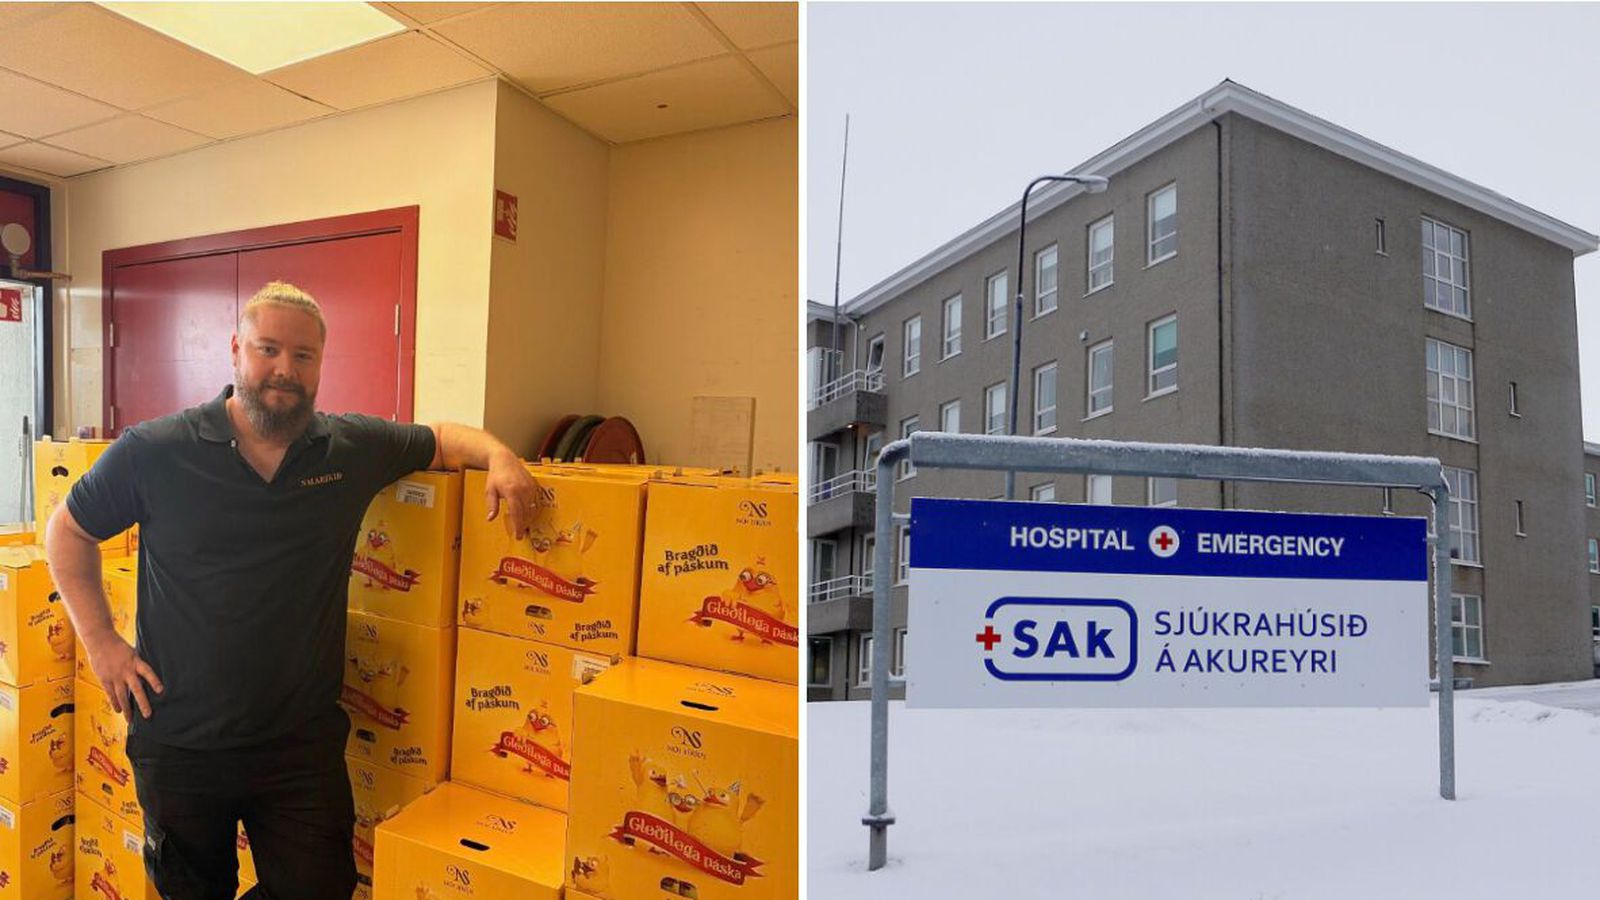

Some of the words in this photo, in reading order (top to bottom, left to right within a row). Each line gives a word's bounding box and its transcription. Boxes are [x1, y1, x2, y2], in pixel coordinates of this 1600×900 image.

[665, 544, 718, 560] Bragðið
[1010, 525, 1134, 552] HOSPITAL
[1198, 532, 1345, 557] EMERGENCY
[503, 560, 554, 590] Gleðilega
[657, 562, 671, 576] af
[674, 559, 729, 576] páskum
[707, 601, 769, 633] Gleðilega
[772, 626, 798, 642] pásk
[1154, 606, 1368, 638] SJÚKRAHÚSIÐ
[1012, 619, 1116, 659] SAk
[1156, 643, 1177, 674] Á
[1183, 649, 1337, 674] AKUREYRI
[465, 698, 475, 711] af
[478, 698, 520, 712] páskum
[470, 685, 512, 699] Bragðið
[629, 815, 701, 861] Gleðilega
[703, 853, 742, 881] páska
